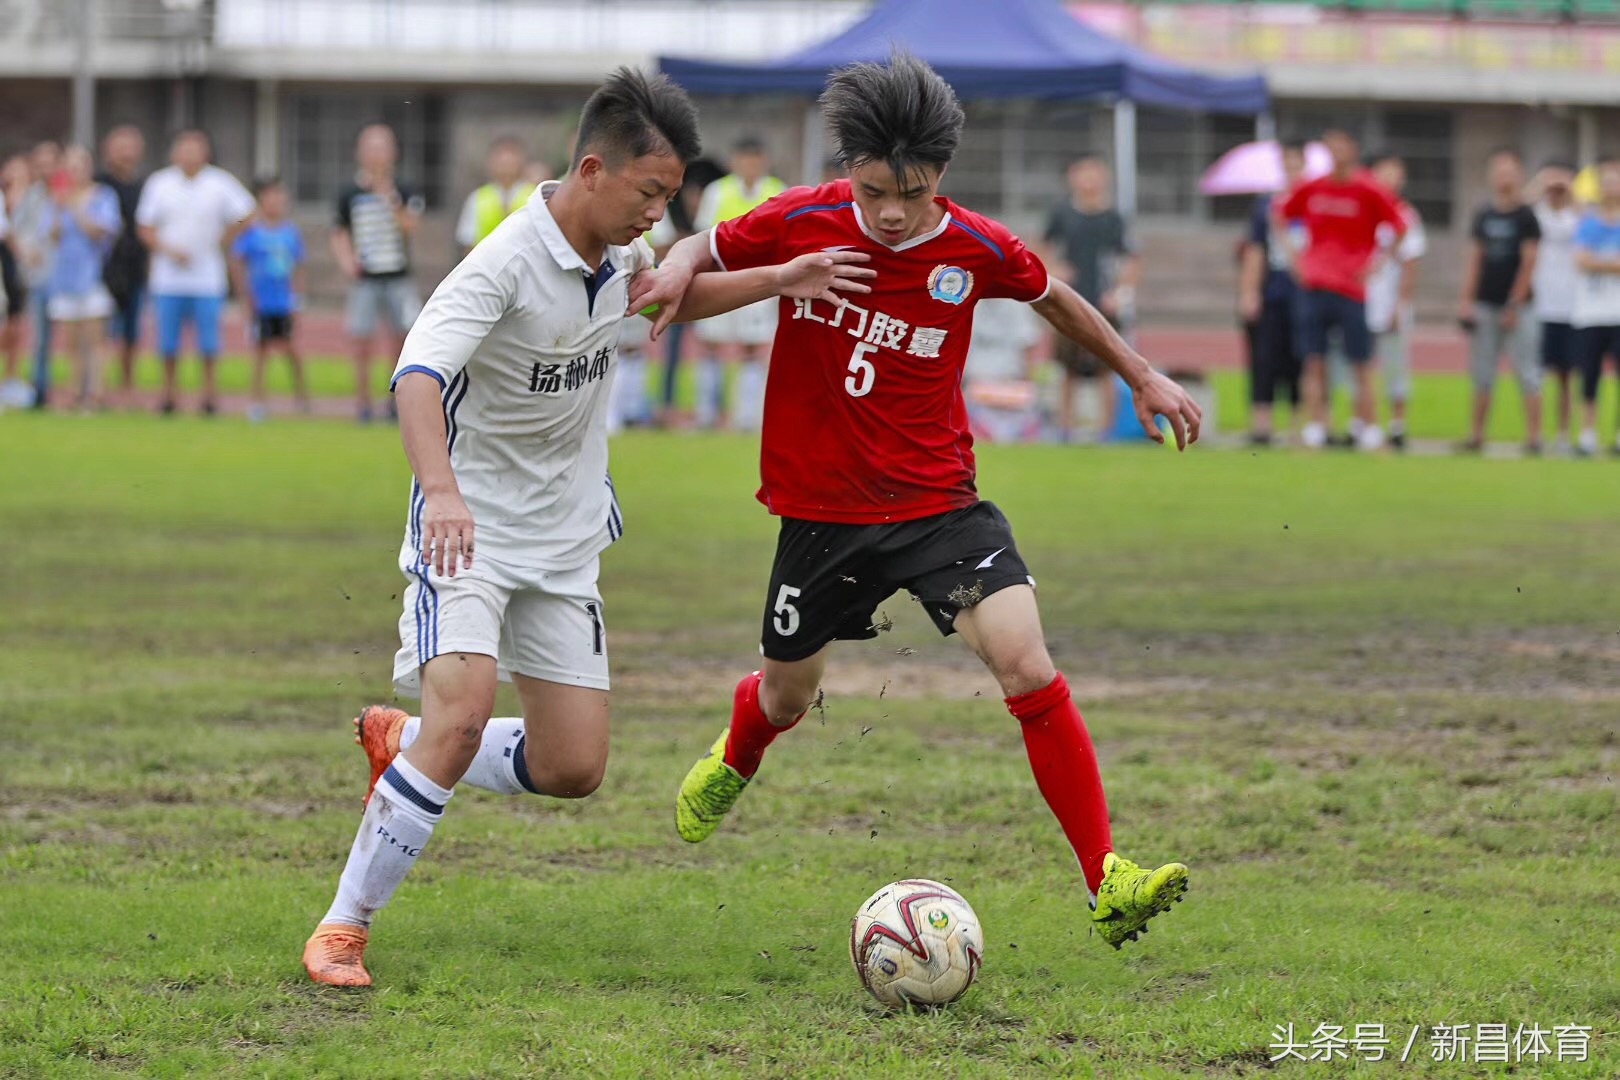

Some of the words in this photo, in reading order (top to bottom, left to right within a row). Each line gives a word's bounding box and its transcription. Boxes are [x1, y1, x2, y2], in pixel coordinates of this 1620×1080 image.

[527, 344, 617, 393] 扬帆体
[844, 341, 879, 398] 5
[773, 583, 802, 637] 5
